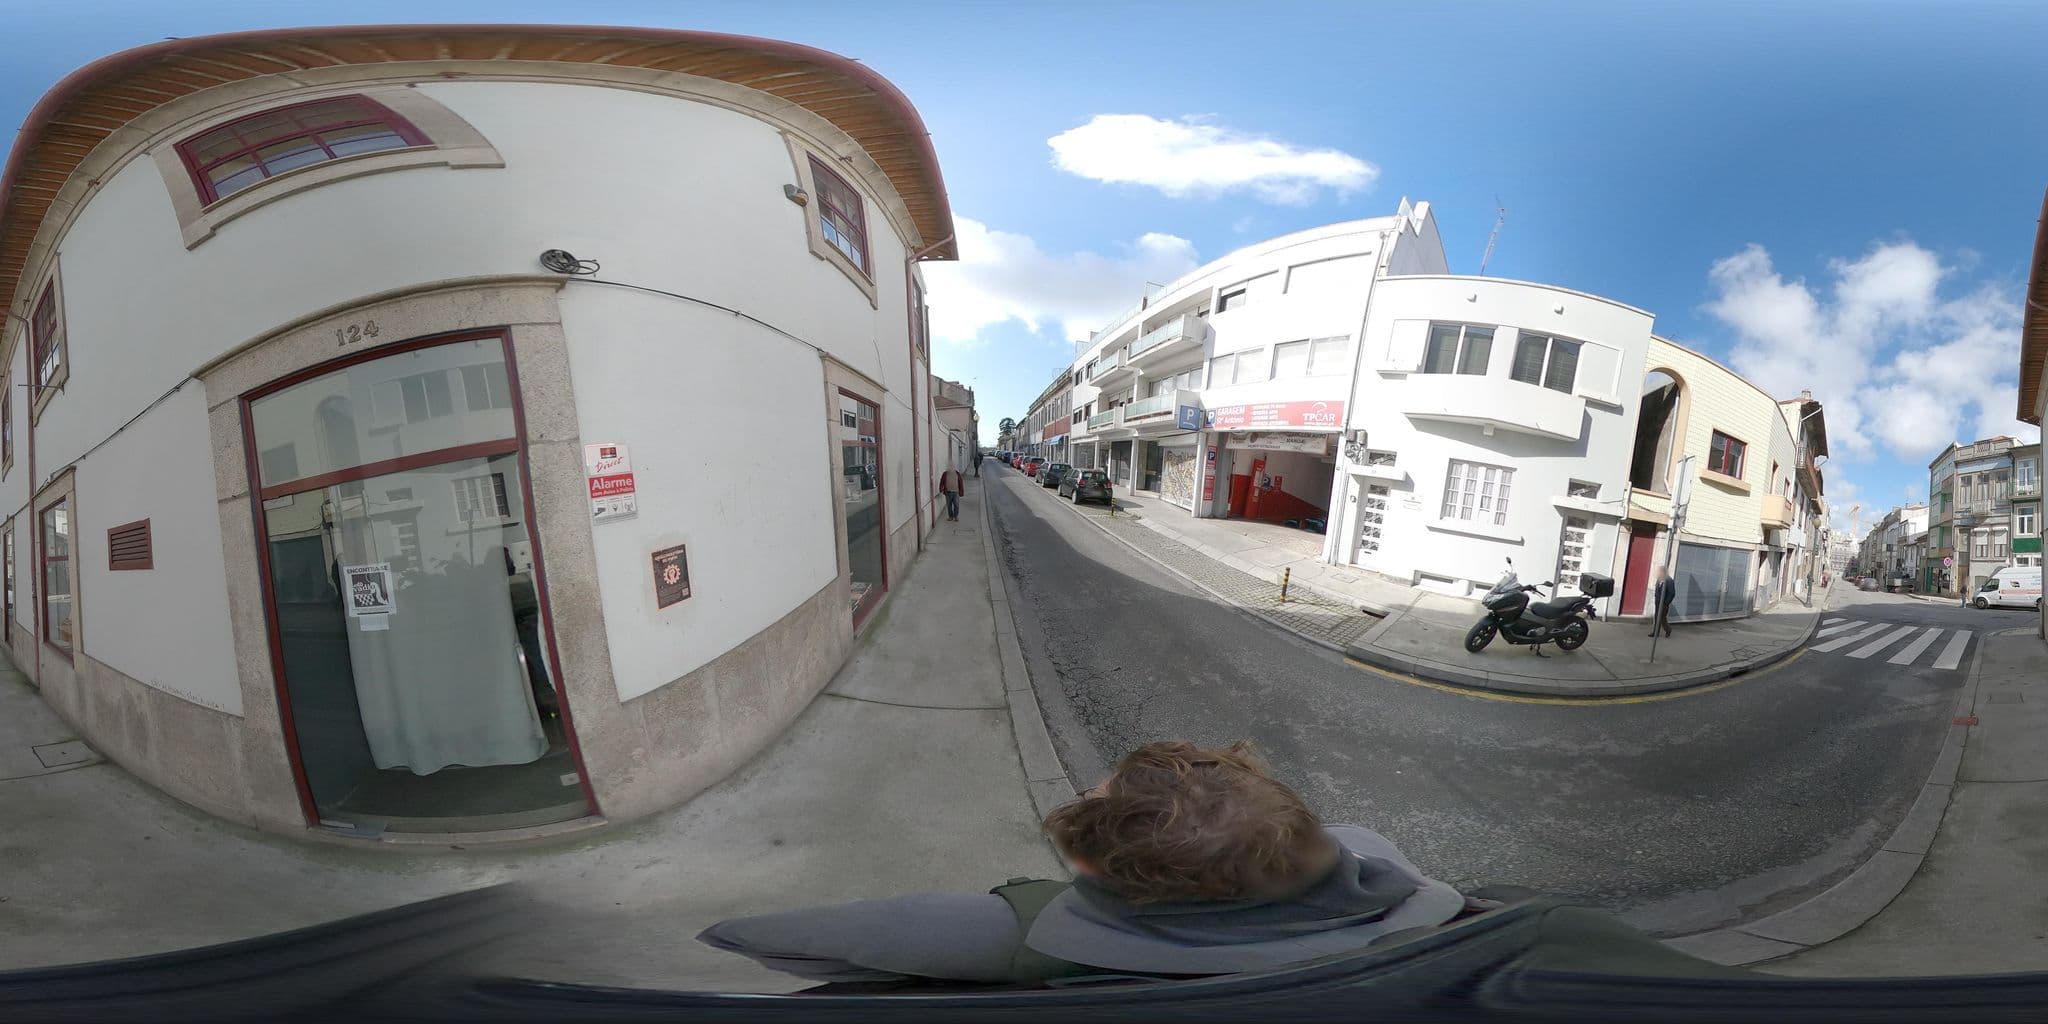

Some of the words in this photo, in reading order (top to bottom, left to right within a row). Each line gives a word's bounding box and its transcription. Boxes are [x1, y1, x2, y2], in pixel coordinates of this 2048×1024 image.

[335, 320, 380, 347] 124
[1186, 408, 1195, 421] P
[1208, 411, 1215, 422] P
[591, 477, 633, 491] Alarme
